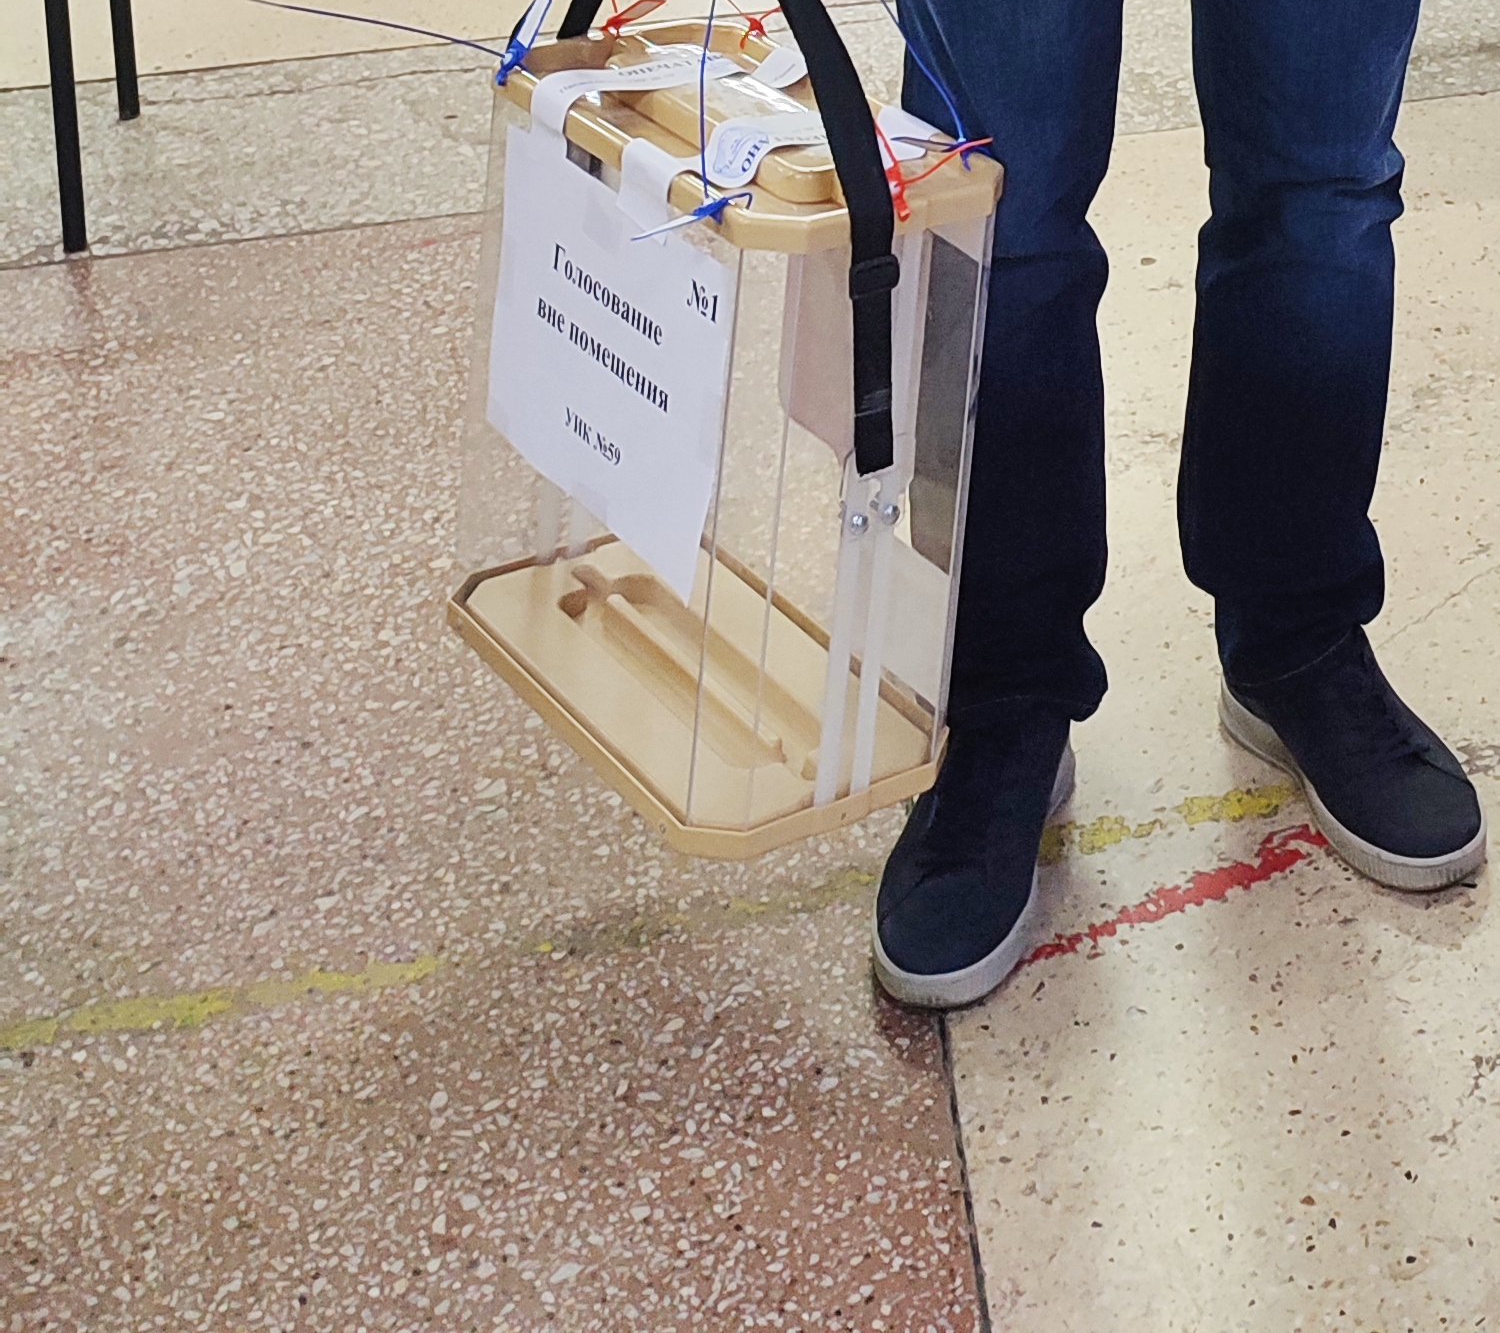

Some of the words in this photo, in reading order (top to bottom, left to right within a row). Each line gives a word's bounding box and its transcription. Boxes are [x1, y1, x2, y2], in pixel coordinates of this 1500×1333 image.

[553, 242, 663, 347] Голосование
[686, 279, 719, 324] №1
[537, 296, 566, 334] вне
[569, 321, 669, 414] помещения
[565, 406, 592, 446] УИК
[593, 431, 621, 466] №59
